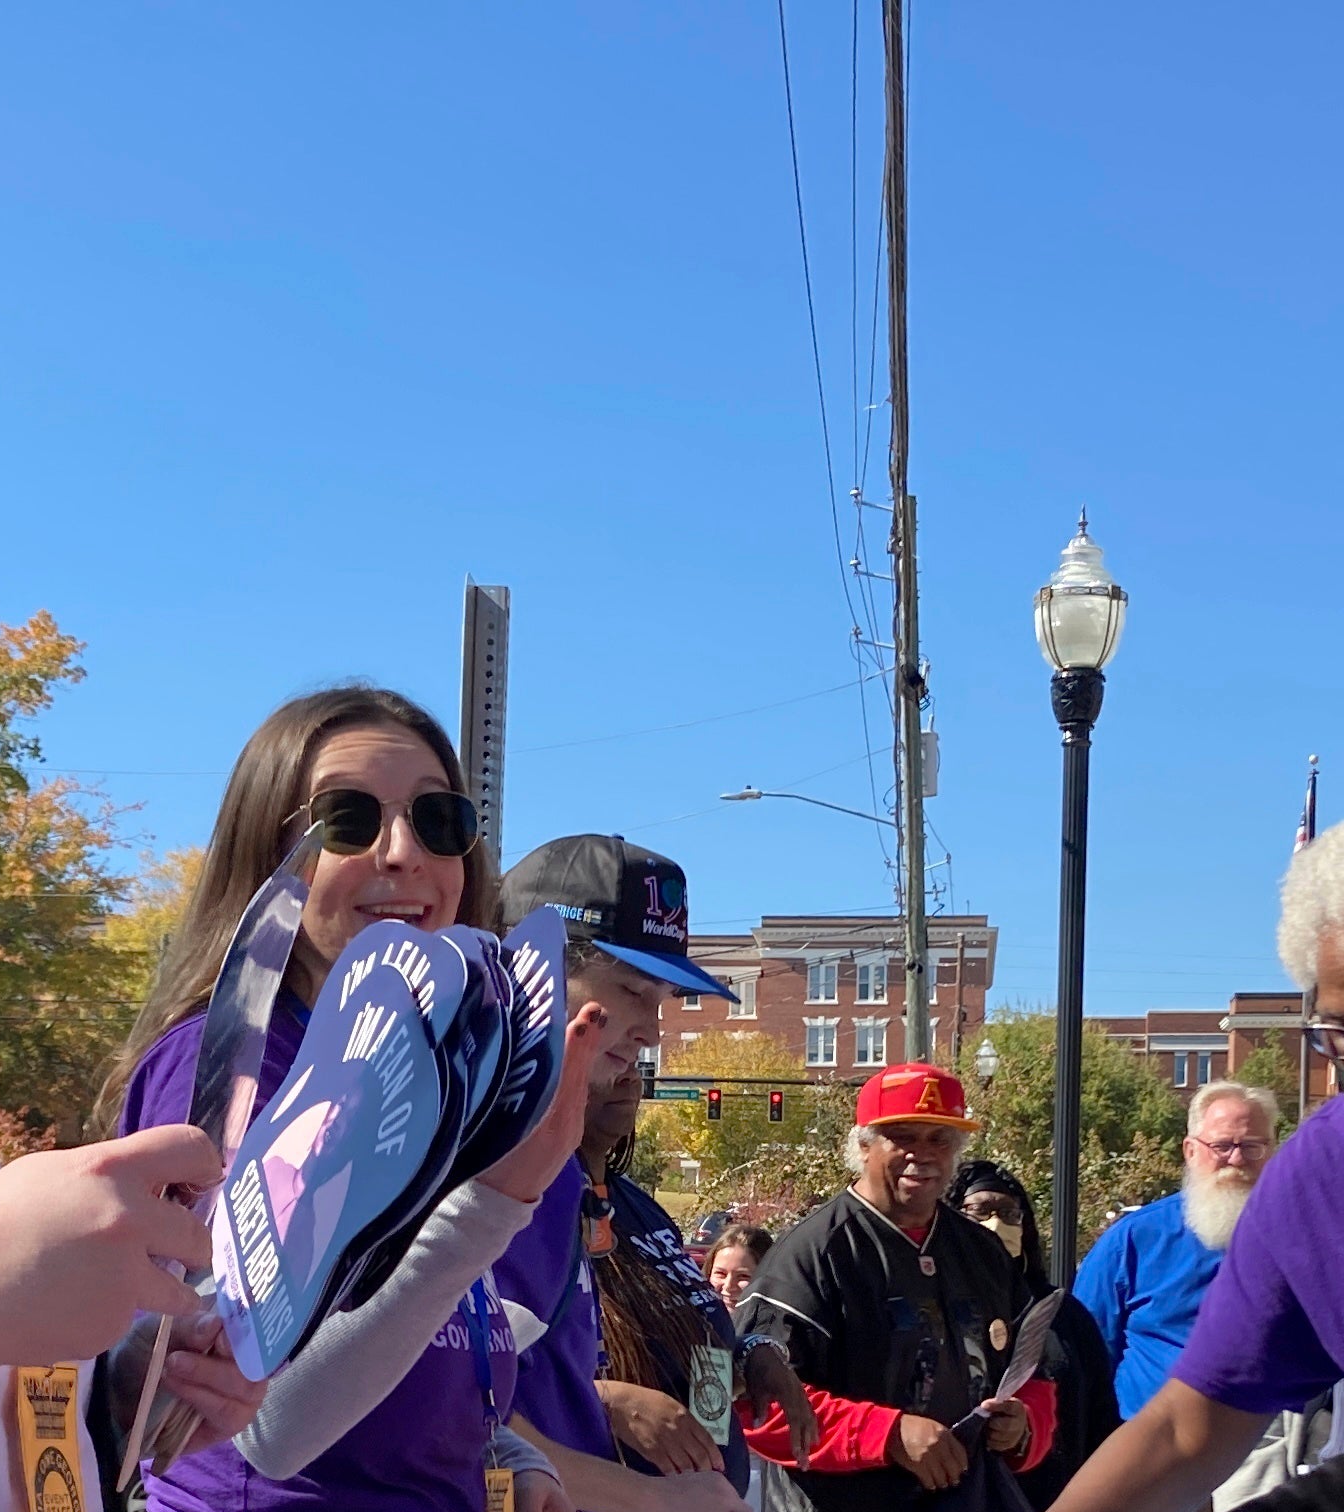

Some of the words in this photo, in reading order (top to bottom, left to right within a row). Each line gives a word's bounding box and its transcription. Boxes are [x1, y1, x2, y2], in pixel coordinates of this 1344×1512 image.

[374, 1024, 415, 1112] FAN
[915, 1077, 946, 1112] A
[374, 1101, 413, 1156] OF
[230, 1159, 269, 1256] STACEY
